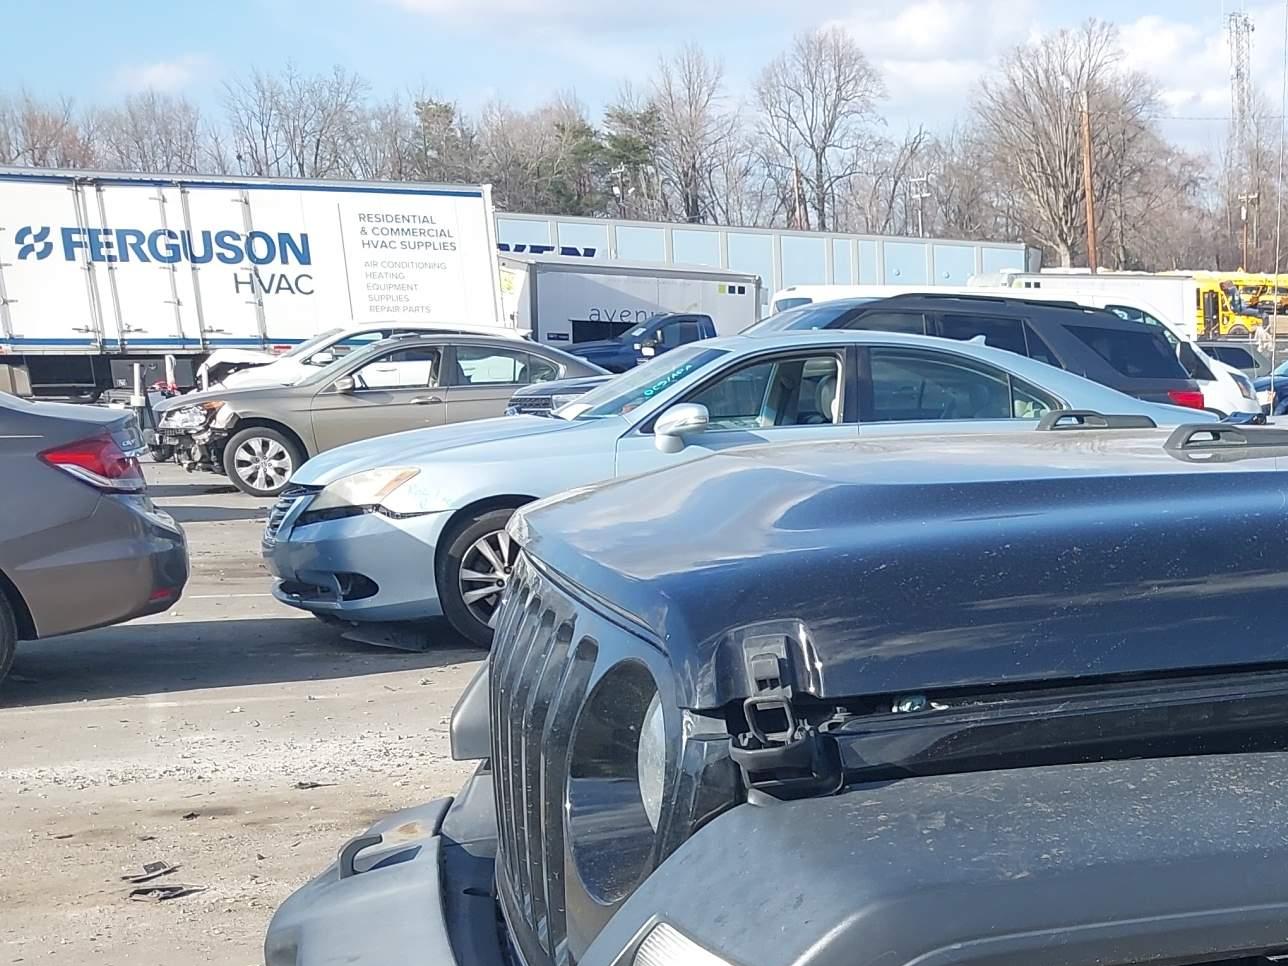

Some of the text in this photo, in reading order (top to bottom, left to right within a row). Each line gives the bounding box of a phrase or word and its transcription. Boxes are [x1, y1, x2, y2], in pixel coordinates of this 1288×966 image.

[358, 213, 437, 225] RESIDENTIAL
[360, 226, 455, 238] & COMMERCIAL
[60, 227, 312, 266] FERGUSON
[361, 240, 457, 251] HVAC SUPPLIES
[380, 261, 447, 270] CONDITIONING
[365, 272, 405, 280] HEATING
[233, 273, 315, 295] HVAC
[366, 283, 418, 291] EQUIPMENT
[368, 294, 410, 302] SUPPLIES
[369, 305, 431, 314] REPAIR PARTS
[588, 308, 657, 322] aven
